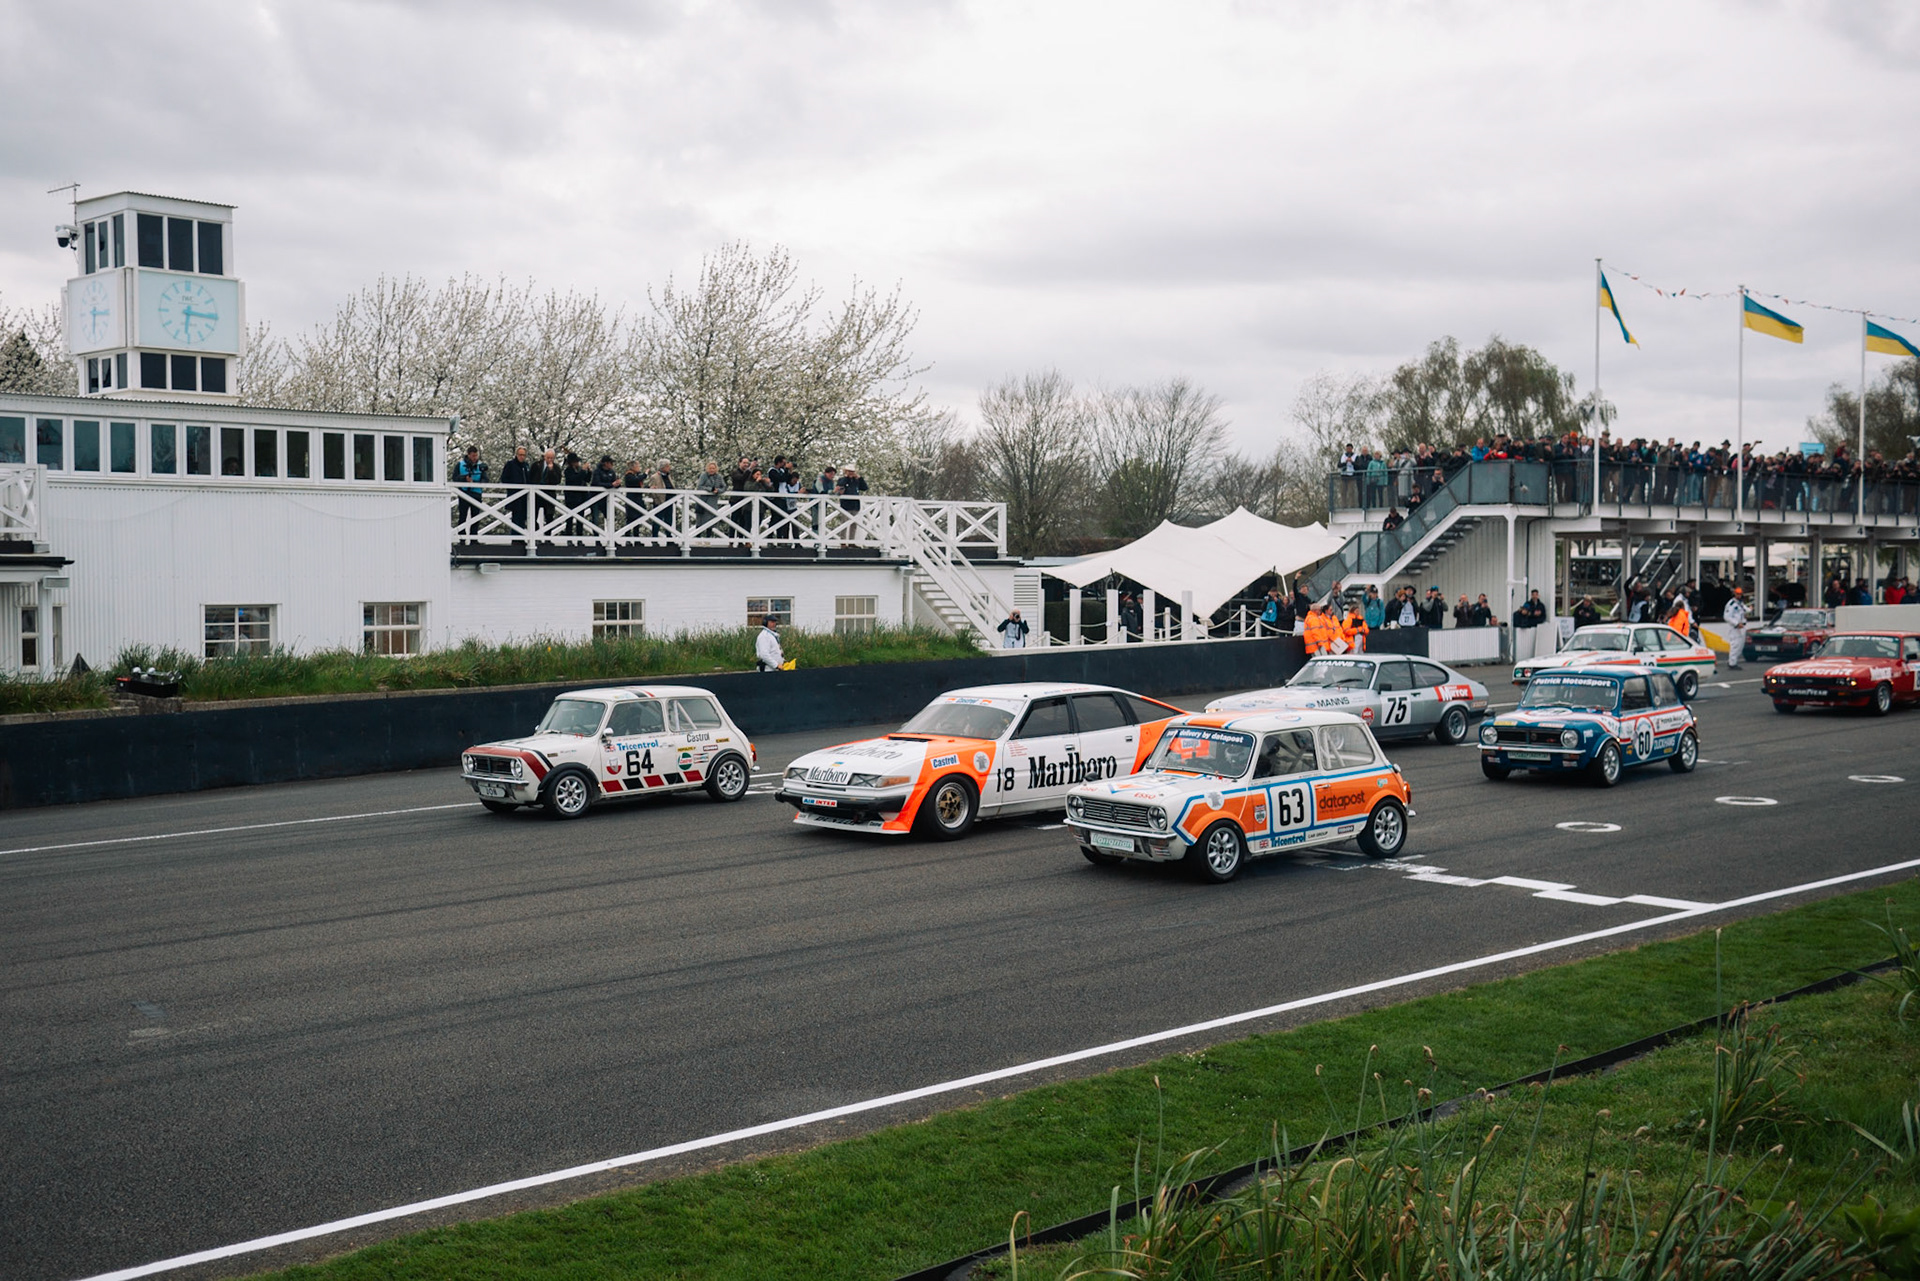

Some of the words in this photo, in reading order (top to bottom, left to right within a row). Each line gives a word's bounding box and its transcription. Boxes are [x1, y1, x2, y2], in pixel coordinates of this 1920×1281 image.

[1736, 522, 1742, 532] 2
[1799, 524, 1805, 534] 3
[1857, 526, 1863, 535] 4
[1911, 528, 1917, 537] 5
[1535, 678, 1562, 686] Patrick
[1562, 678, 1611, 688] MotorSport
[1439, 686, 1469, 701] Mirror
[1316, 696, 1350, 708] MANNS
[1384, 696, 1408, 724] 75
[686, 732, 710, 743] Castrol
[1179, 729, 1202, 738] delivery
[1202, 731, 1211, 739] by
[1211, 733, 1244, 743] datapost
[616, 739, 659, 752] Tricentrol
[1638, 731, 1650, 756] 60
[625, 749, 654, 776] 64
[932, 755, 957, 769] Castrol
[808, 766, 848, 783] Marlboro
[1027, 752, 1118, 790] Marlboro
[996, 767, 1016, 792] 18
[1278, 788, 1304, 827] 63
[1319, 792, 1365, 811] datapost
[1270, 832, 1305, 848] Tricentrol
